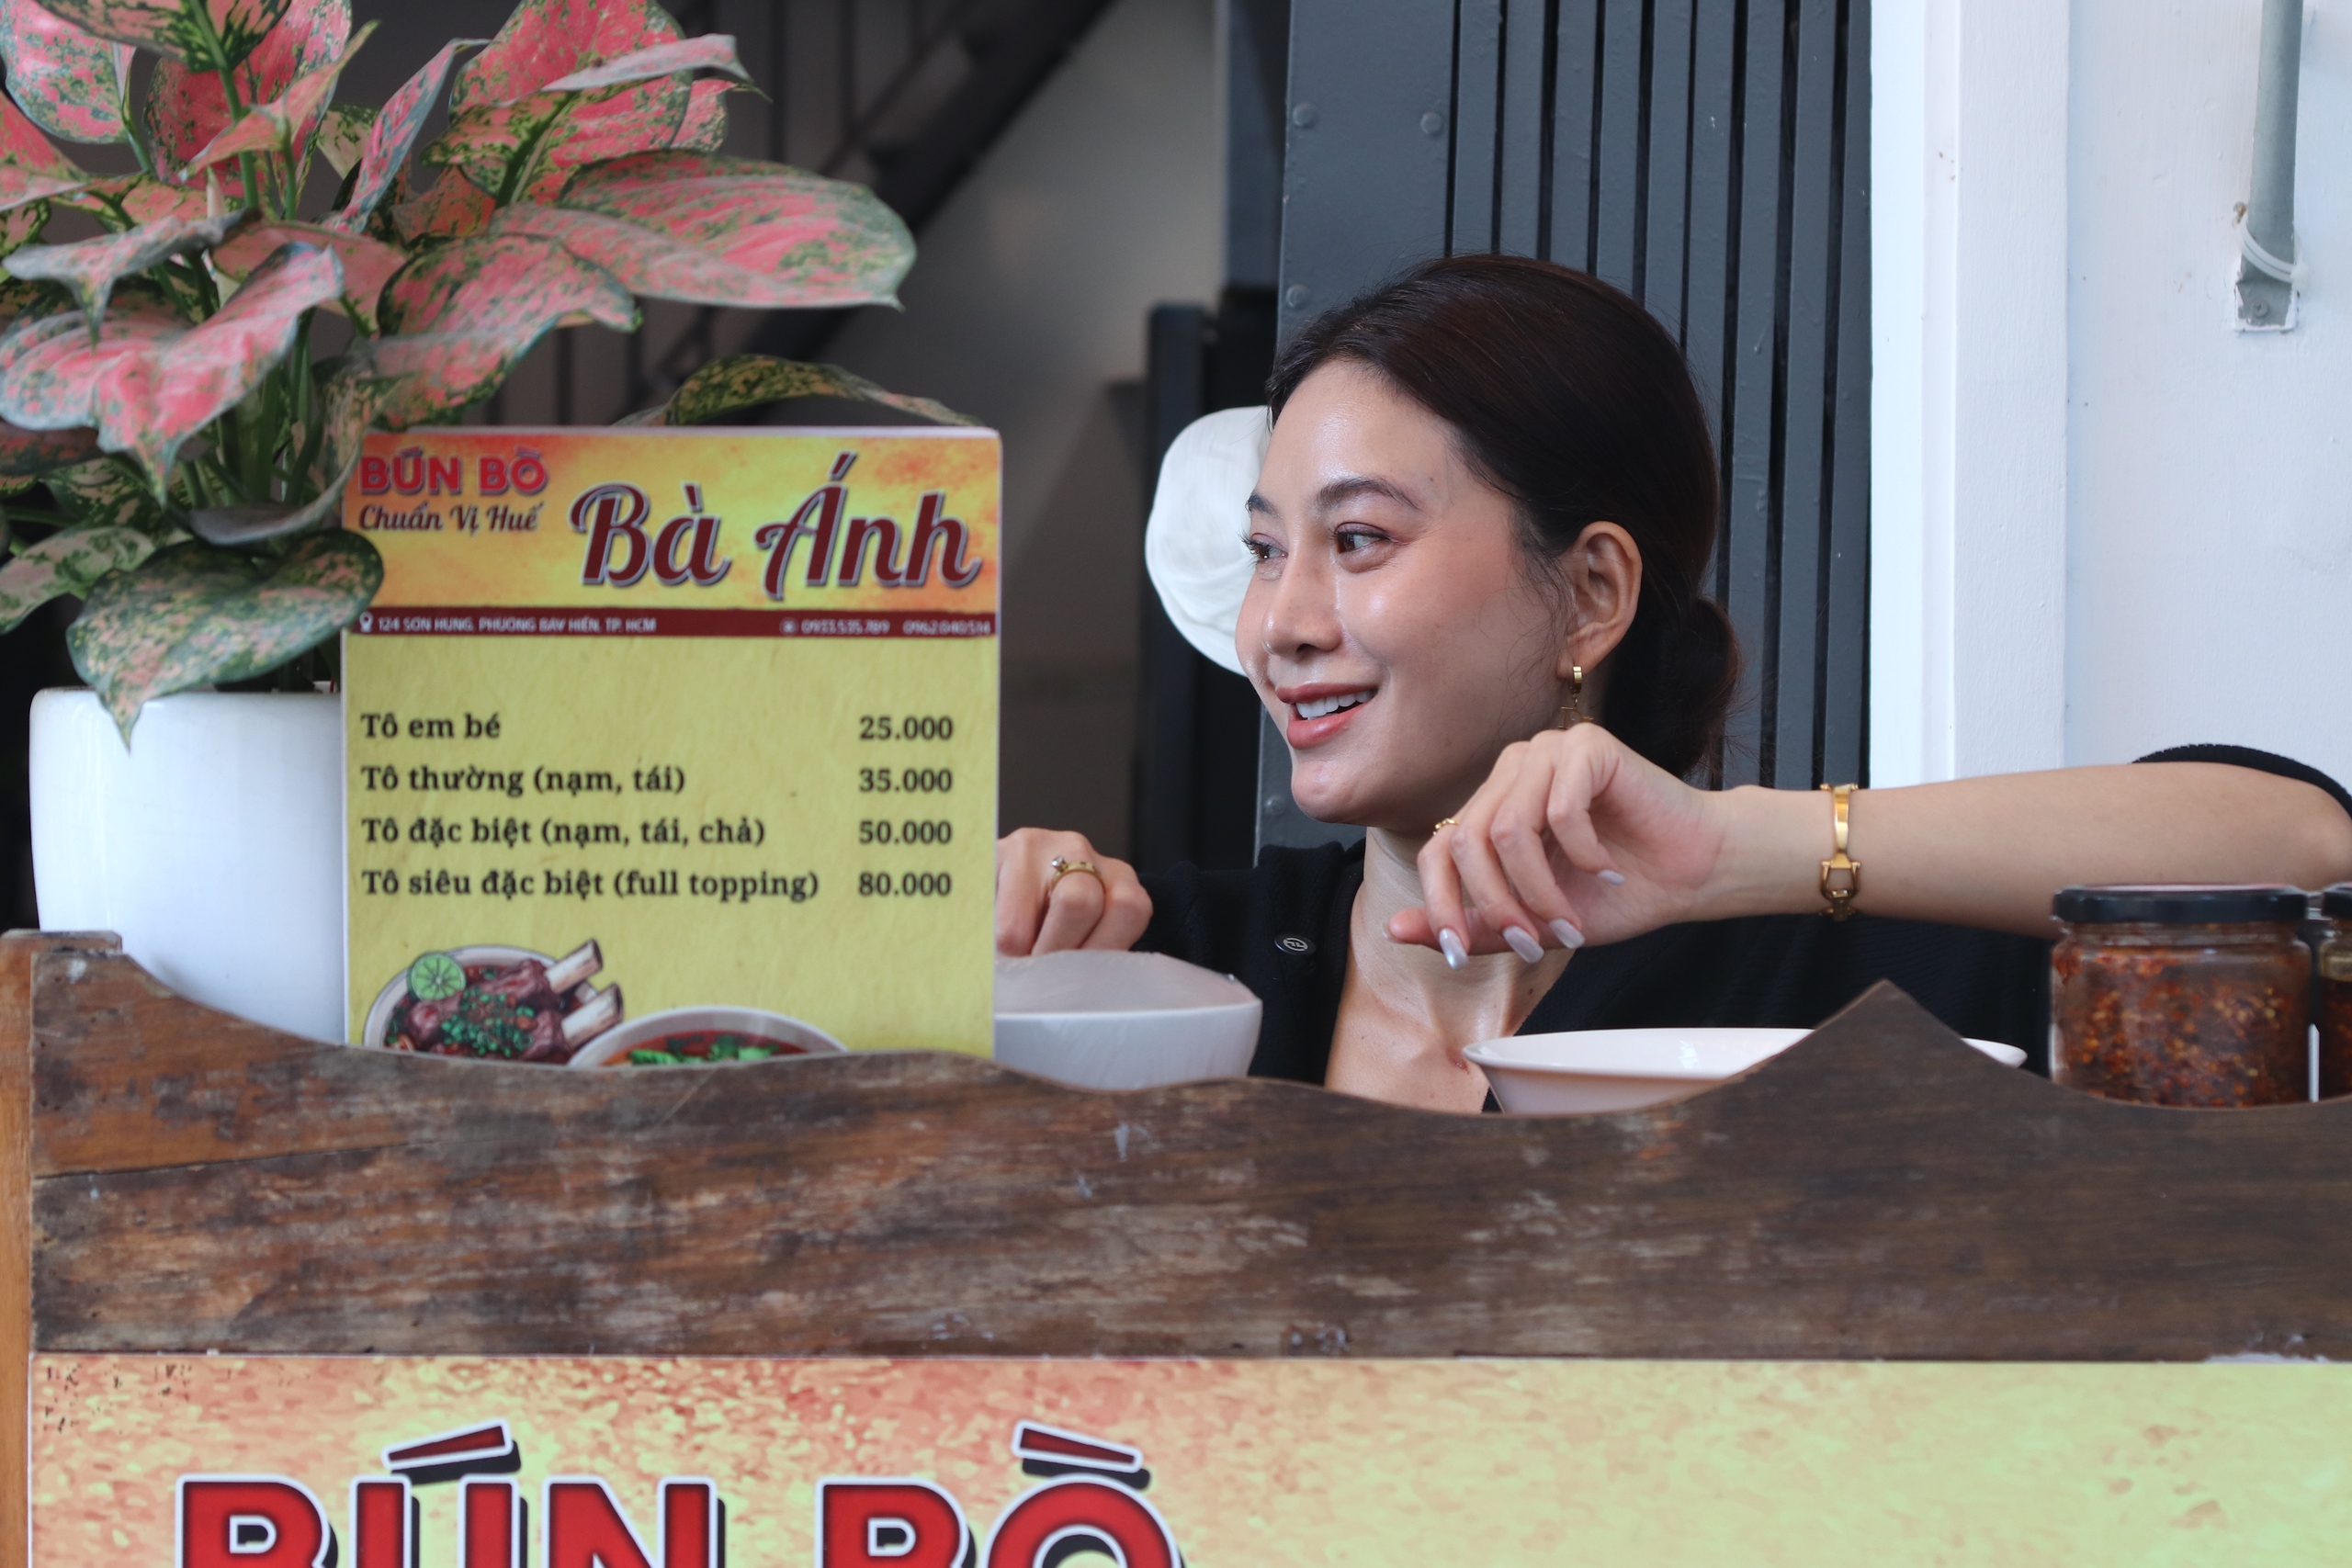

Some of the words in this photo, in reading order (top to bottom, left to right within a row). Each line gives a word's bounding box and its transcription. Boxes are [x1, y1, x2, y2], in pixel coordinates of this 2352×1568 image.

[359, 446, 462, 496] BÚN
[478, 446, 549, 496] BÒ
[358, 502, 443, 531] Chuẩn
[449, 504, 481, 536] Vị
[486, 502, 545, 531] Huế
[567, 481, 732, 586] Bà
[755, 451, 982, 600] Ánh
[378, 616, 401, 632] 124
[625, 616, 657, 633] HCM
[359, 712, 399, 739] Tô
[407, 718, 455, 739] em
[463, 712, 501, 739] bé
[859, 716, 953, 740] 25.000
[359, 764, 399, 792] Tô
[408, 764, 525, 798] thường
[533, 765, 623, 797] (nạm,
[632, 765, 685, 796] tái)
[859, 768, 953, 794] 35.000
[360, 816, 399, 844] Tô
[408, 817, 462, 849] đặc
[471, 817, 531, 849] biệt
[540, 818, 629, 850] (nạm,
[639, 818, 689, 848] tái,
[698, 816, 765, 848] chả)
[859, 819, 953, 845] 50.000
[361, 868, 400, 896] Tô
[408, 869, 471, 896] siêu
[481, 869, 535, 901] đặc
[544, 869, 604, 901] biệt
[613, 869, 679, 899] (full
[689, 870, 819, 903] topping)
[858, 871, 952, 897] 80.000
